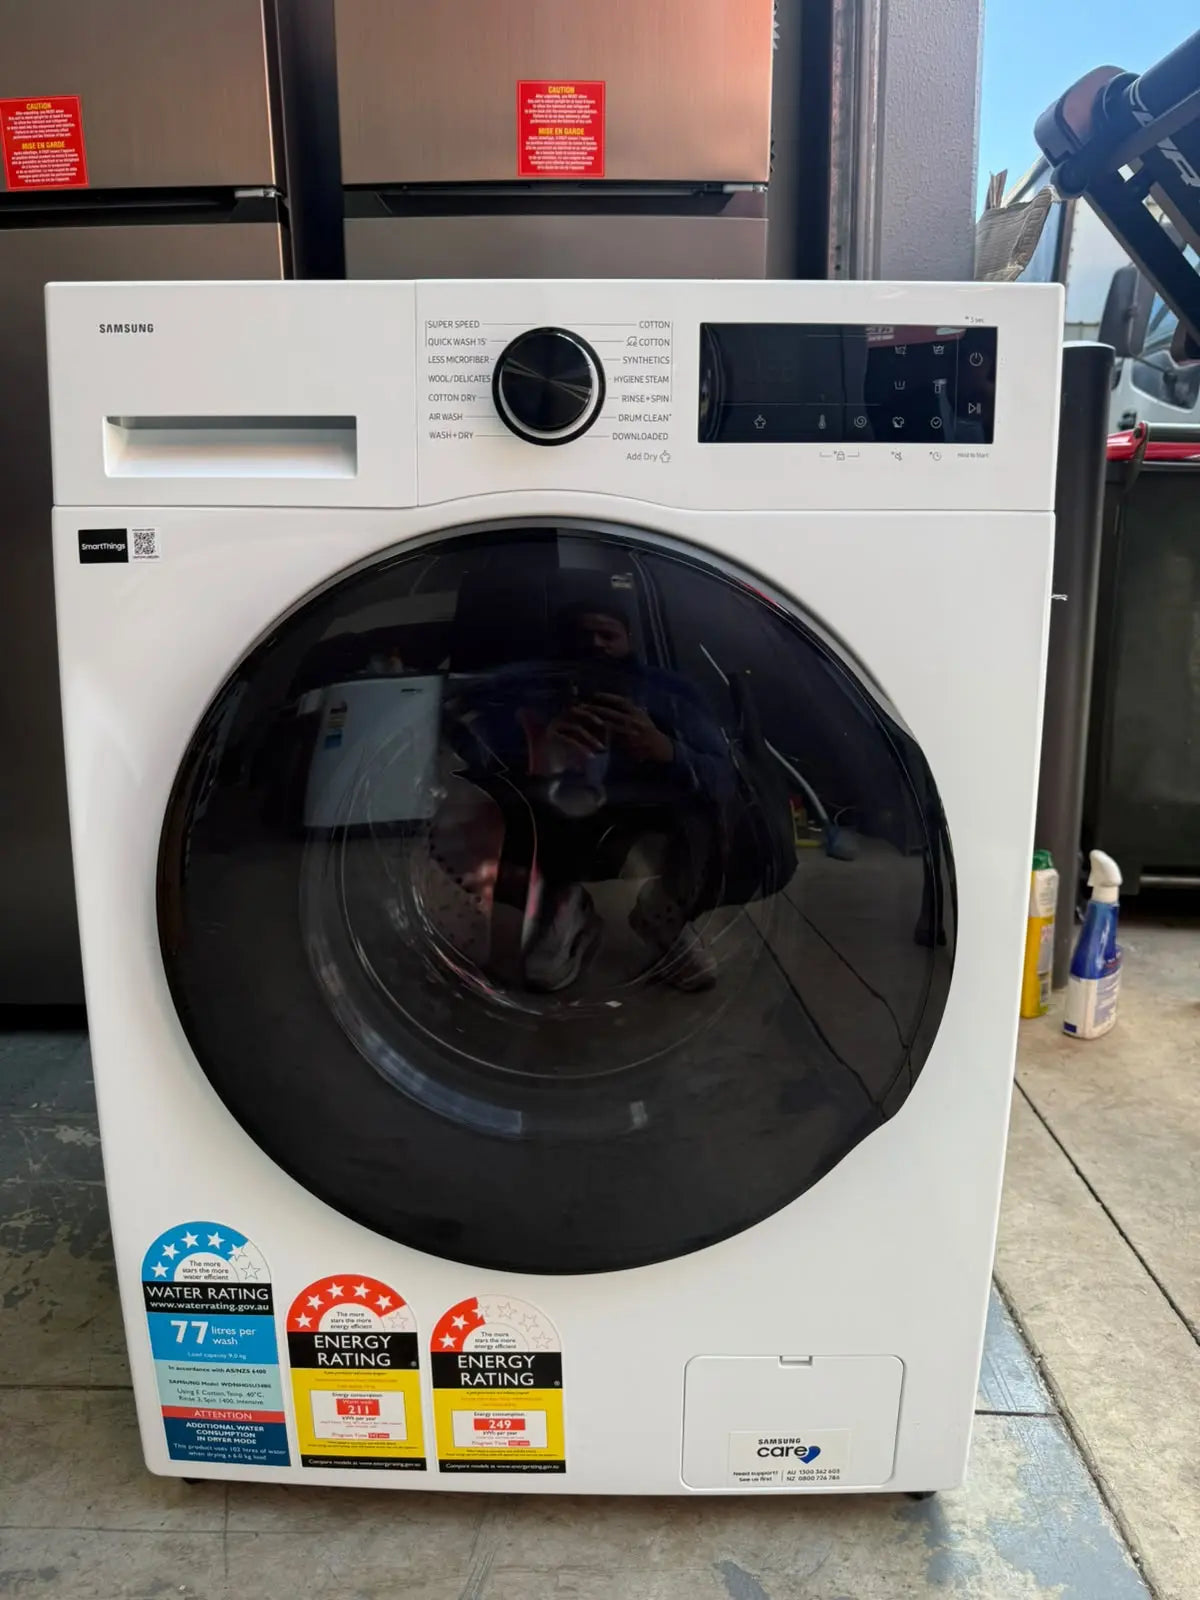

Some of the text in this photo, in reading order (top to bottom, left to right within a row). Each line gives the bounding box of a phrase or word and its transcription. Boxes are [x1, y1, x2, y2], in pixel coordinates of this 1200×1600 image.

[548, 86, 575, 94] CAUTION
[26, 102, 52, 111] CAUTION
[538, 127, 584, 136] MISE EN GARDE
[22, 140, 65, 150] MISE EN GARDE
[99, 324, 154, 333] SAMSUNG
[428, 320, 480, 329] SUPER SPEED
[639, 320, 670, 329] COTTON
[428, 338, 452, 346] QUICK
[453, 338, 476, 346] WASH
[639, 338, 670, 347] COTTON
[428, 355, 490, 364] LESS MICROFIBER
[623, 356, 670, 364] SYNTHETICS
[614, 375, 669, 384] HYGIENE STEAM
[428, 393, 476, 402] COTTON DRY
[429, 412, 463, 421] AIR WASH
[618, 414, 642, 422] DRUM
[612, 432, 669, 440] DOWNLOADED
[626, 452, 658, 462] Add Dry
[81, 542, 126, 552] SmartThings
[146, 1286, 269, 1301] WATER RATING
[149, 1301, 269, 1312] www.waterrating.gov.au
[170, 1319, 209, 1345] 77
[211, 1325, 256, 1337] litres per
[212, 1336, 238, 1345] wash
[313, 1335, 392, 1349] ENERGY
[316, 1352, 392, 1367] RATING
[457, 1355, 536, 1369] ENERGY
[460, 1372, 535, 1387] RATING
[347, 1405, 370, 1415] 211
[194, 1410, 253, 1420] ATTENTION
[186, 1422, 237, 1431] ADDITIONAL
[488, 1419, 512, 1429] 249
[196, 1430, 256, 1438] CONSUMPTION
[757, 1446, 808, 1458] care
